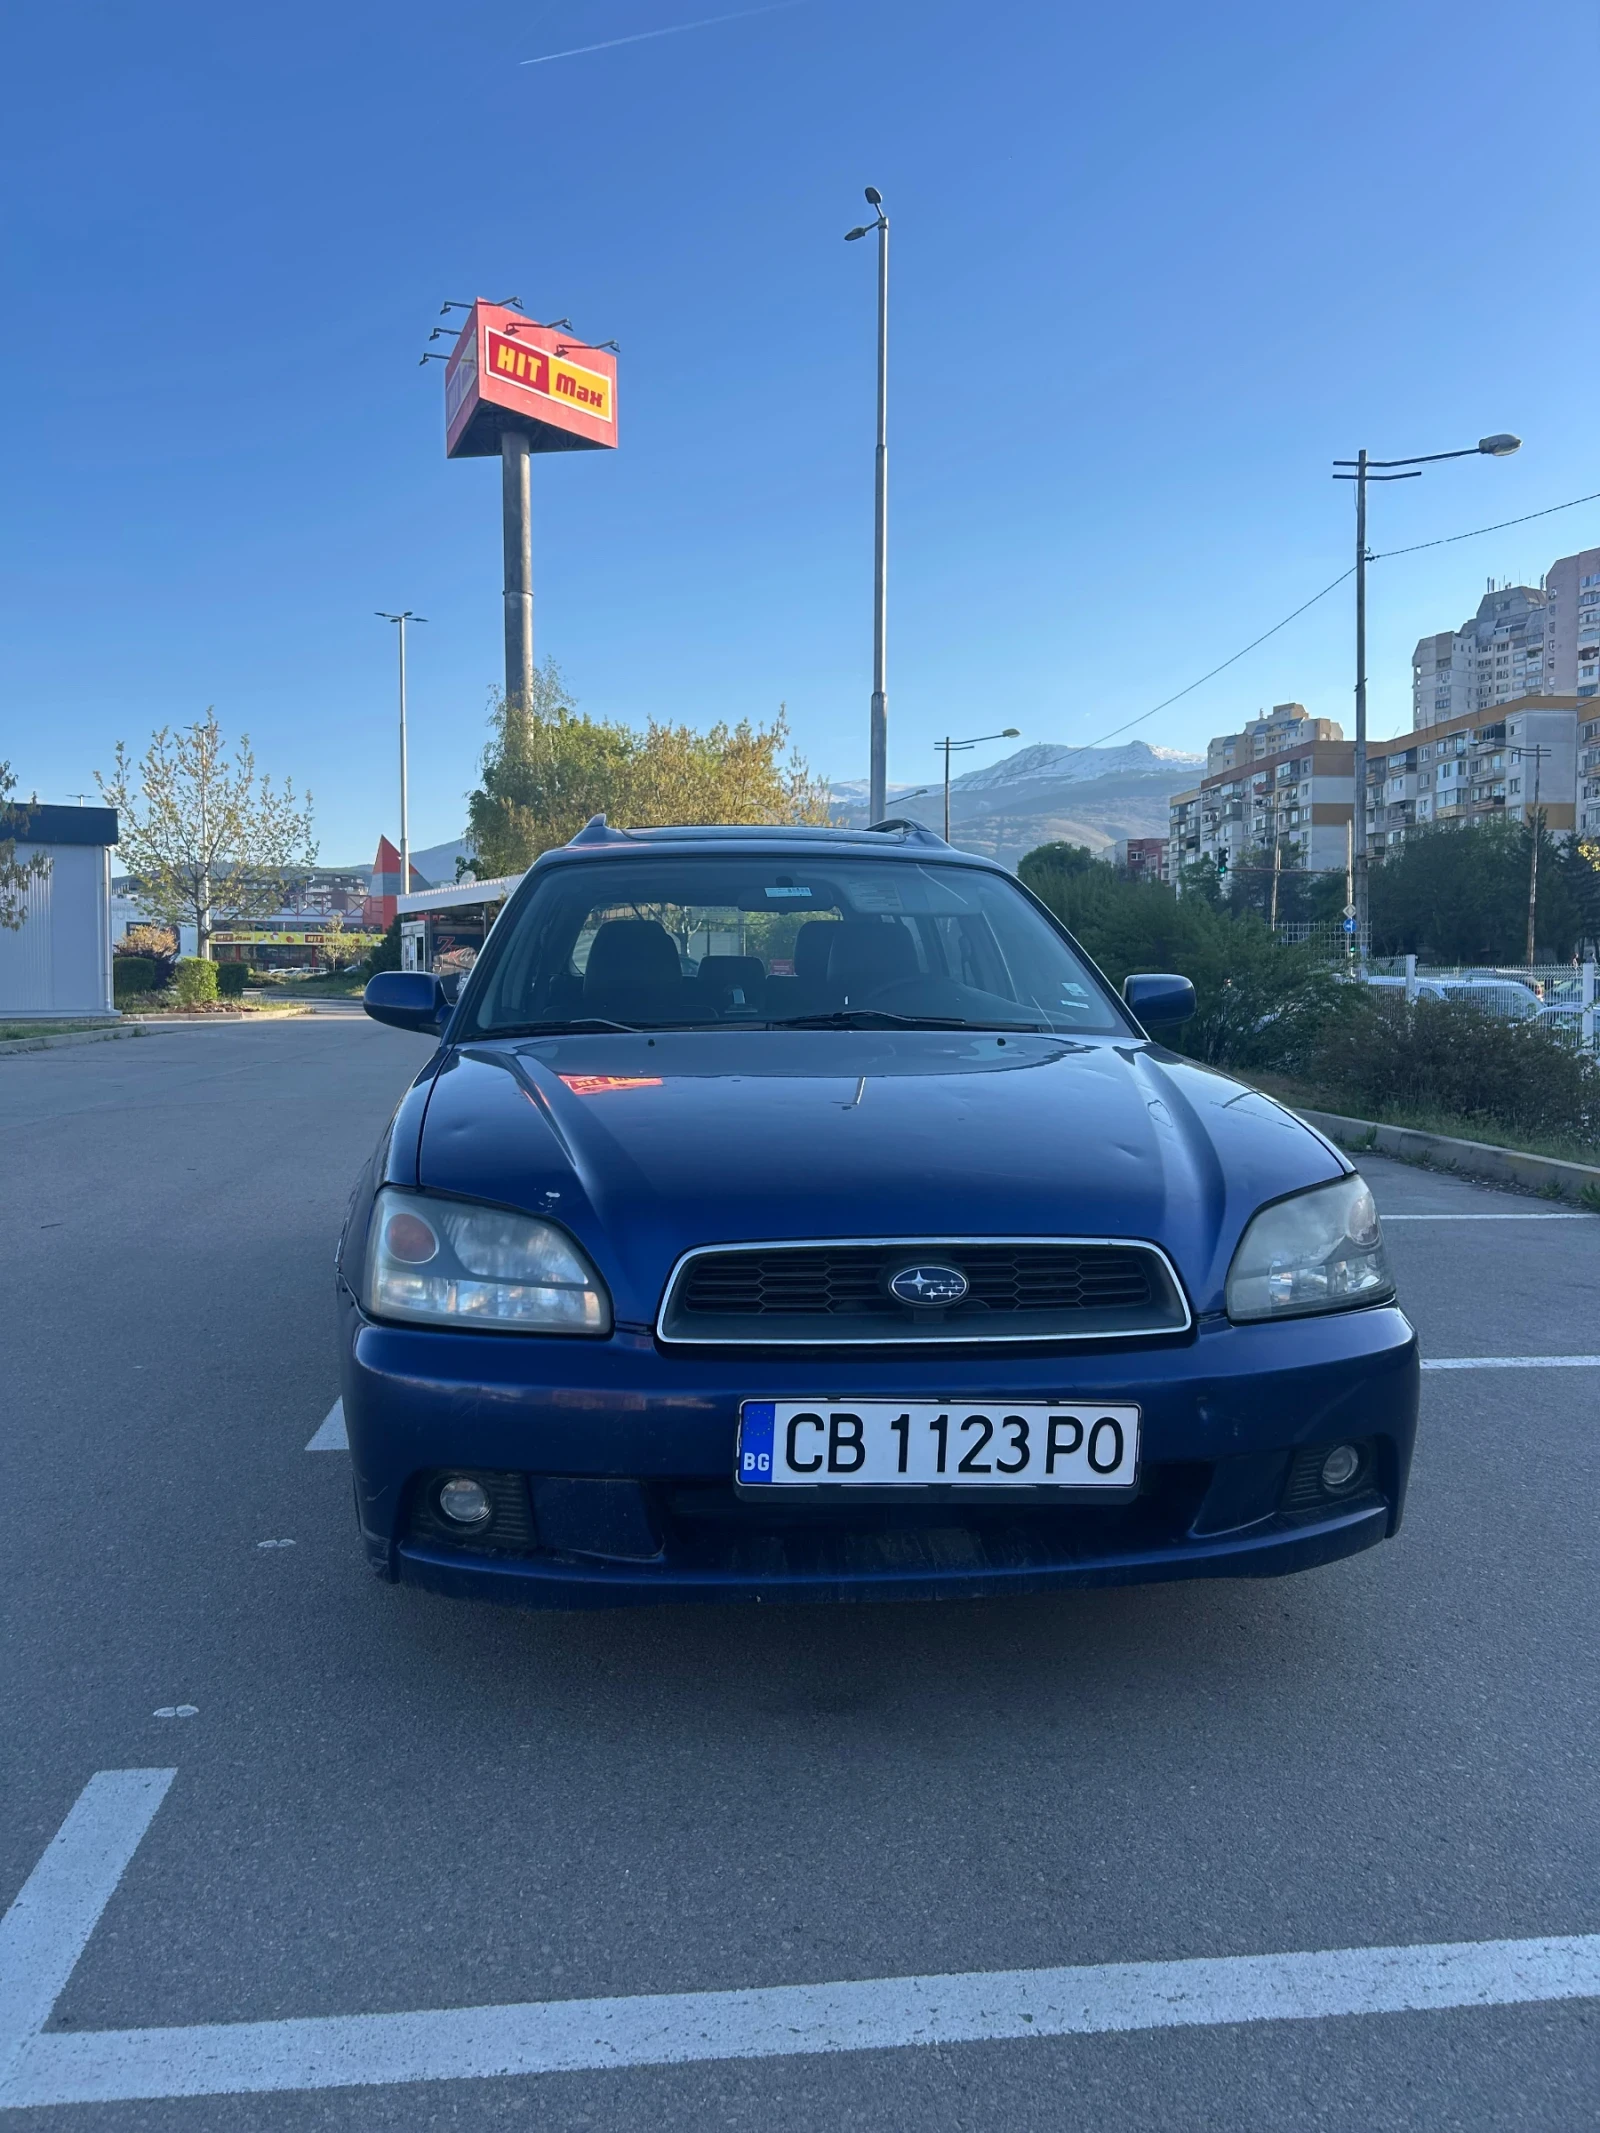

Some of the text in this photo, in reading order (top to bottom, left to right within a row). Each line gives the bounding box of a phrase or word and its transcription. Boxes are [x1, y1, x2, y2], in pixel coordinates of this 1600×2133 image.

[497, 344, 542, 383] HIT
[743, 1452, 770, 1472] BG
[785, 1412, 1125, 1474] CB 1123 PO
